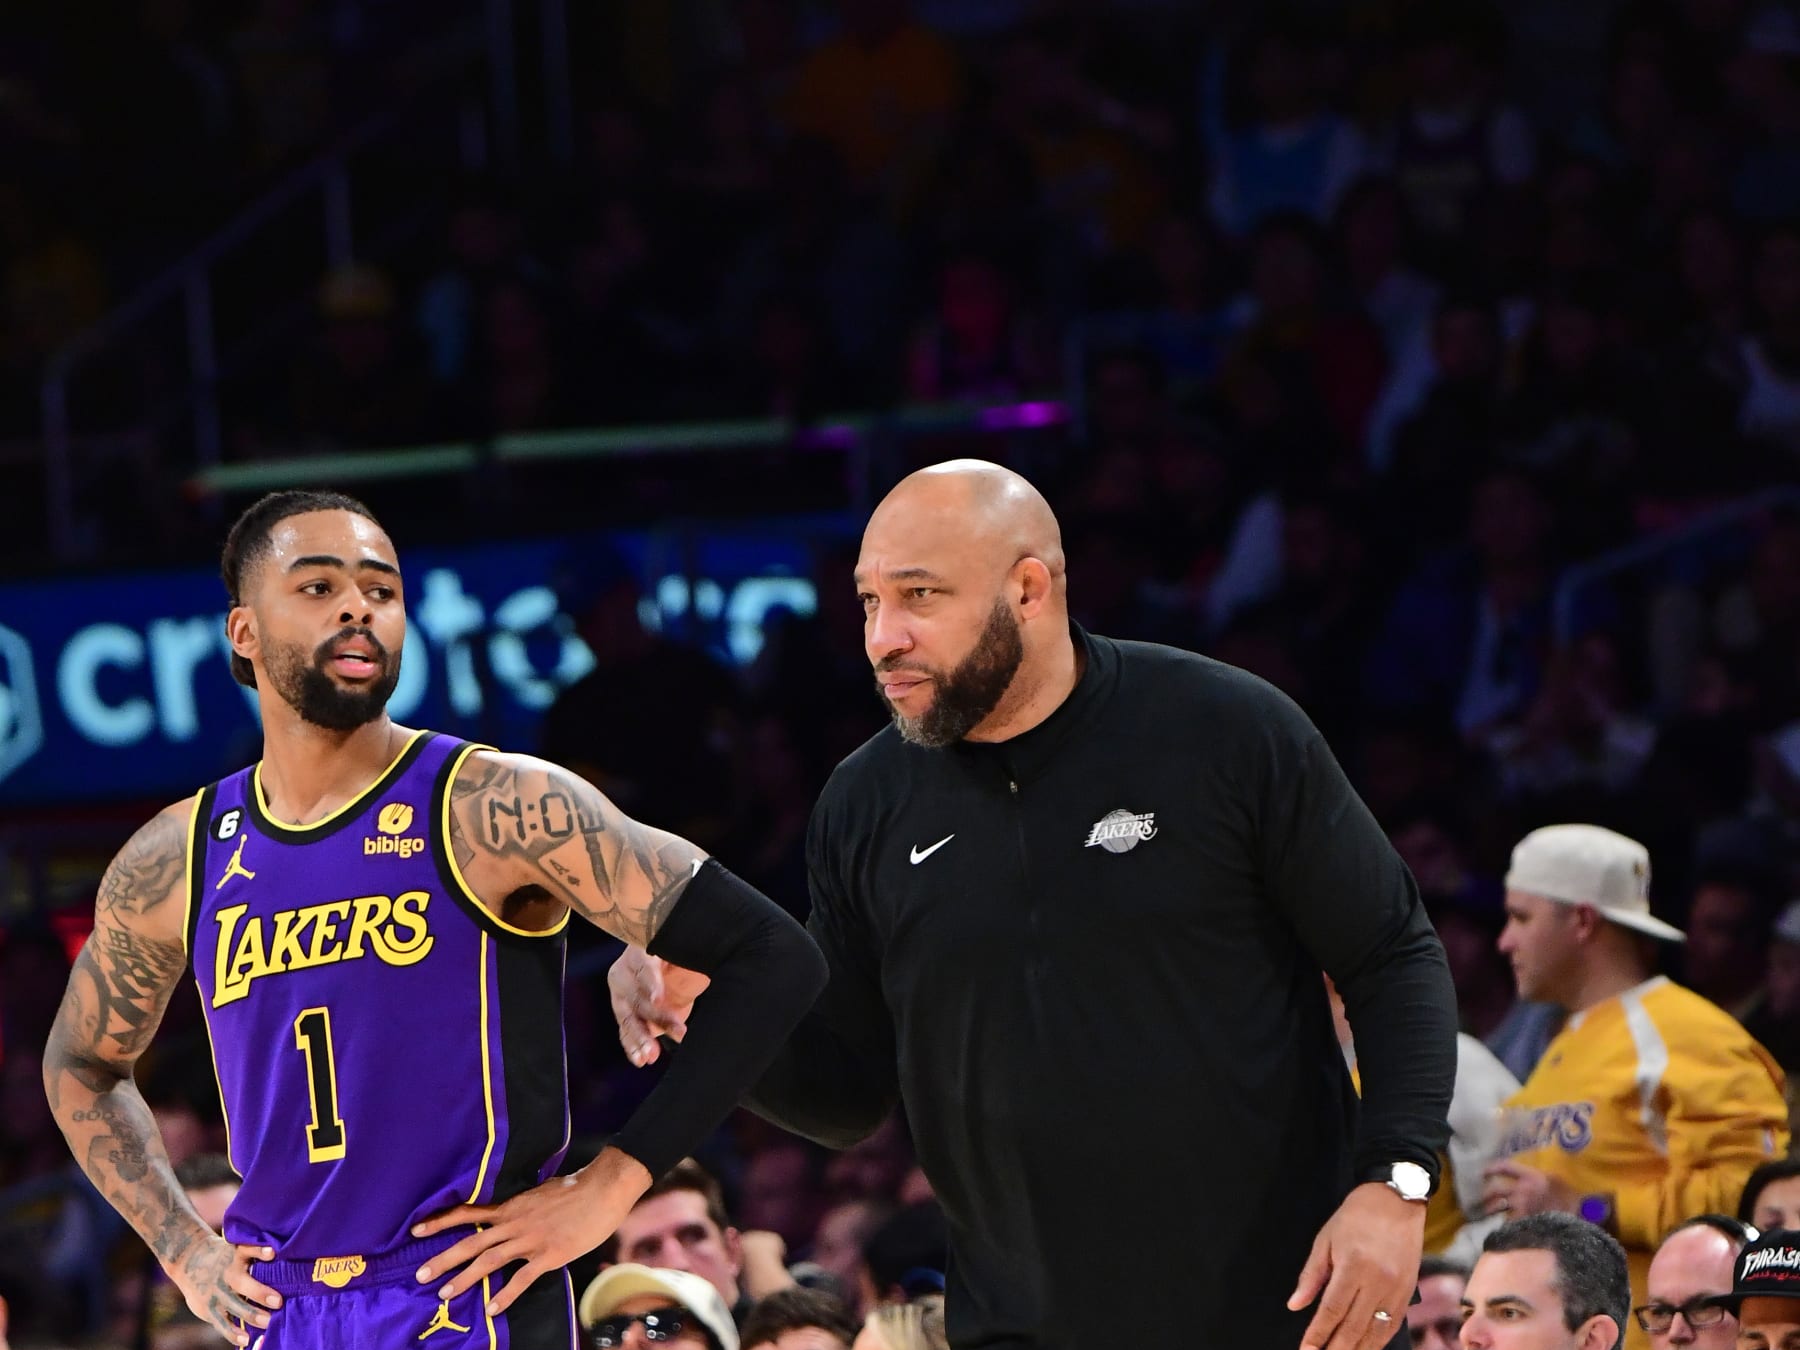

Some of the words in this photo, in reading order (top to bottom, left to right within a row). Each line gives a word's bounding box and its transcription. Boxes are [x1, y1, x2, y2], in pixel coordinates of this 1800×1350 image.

[217, 810, 241, 840] 6
[1084, 819, 1158, 848] LAKERS
[364, 836, 425, 859] bibigo
[212, 890, 435, 1009] LAKERS
[294, 1006, 346, 1164] 1
